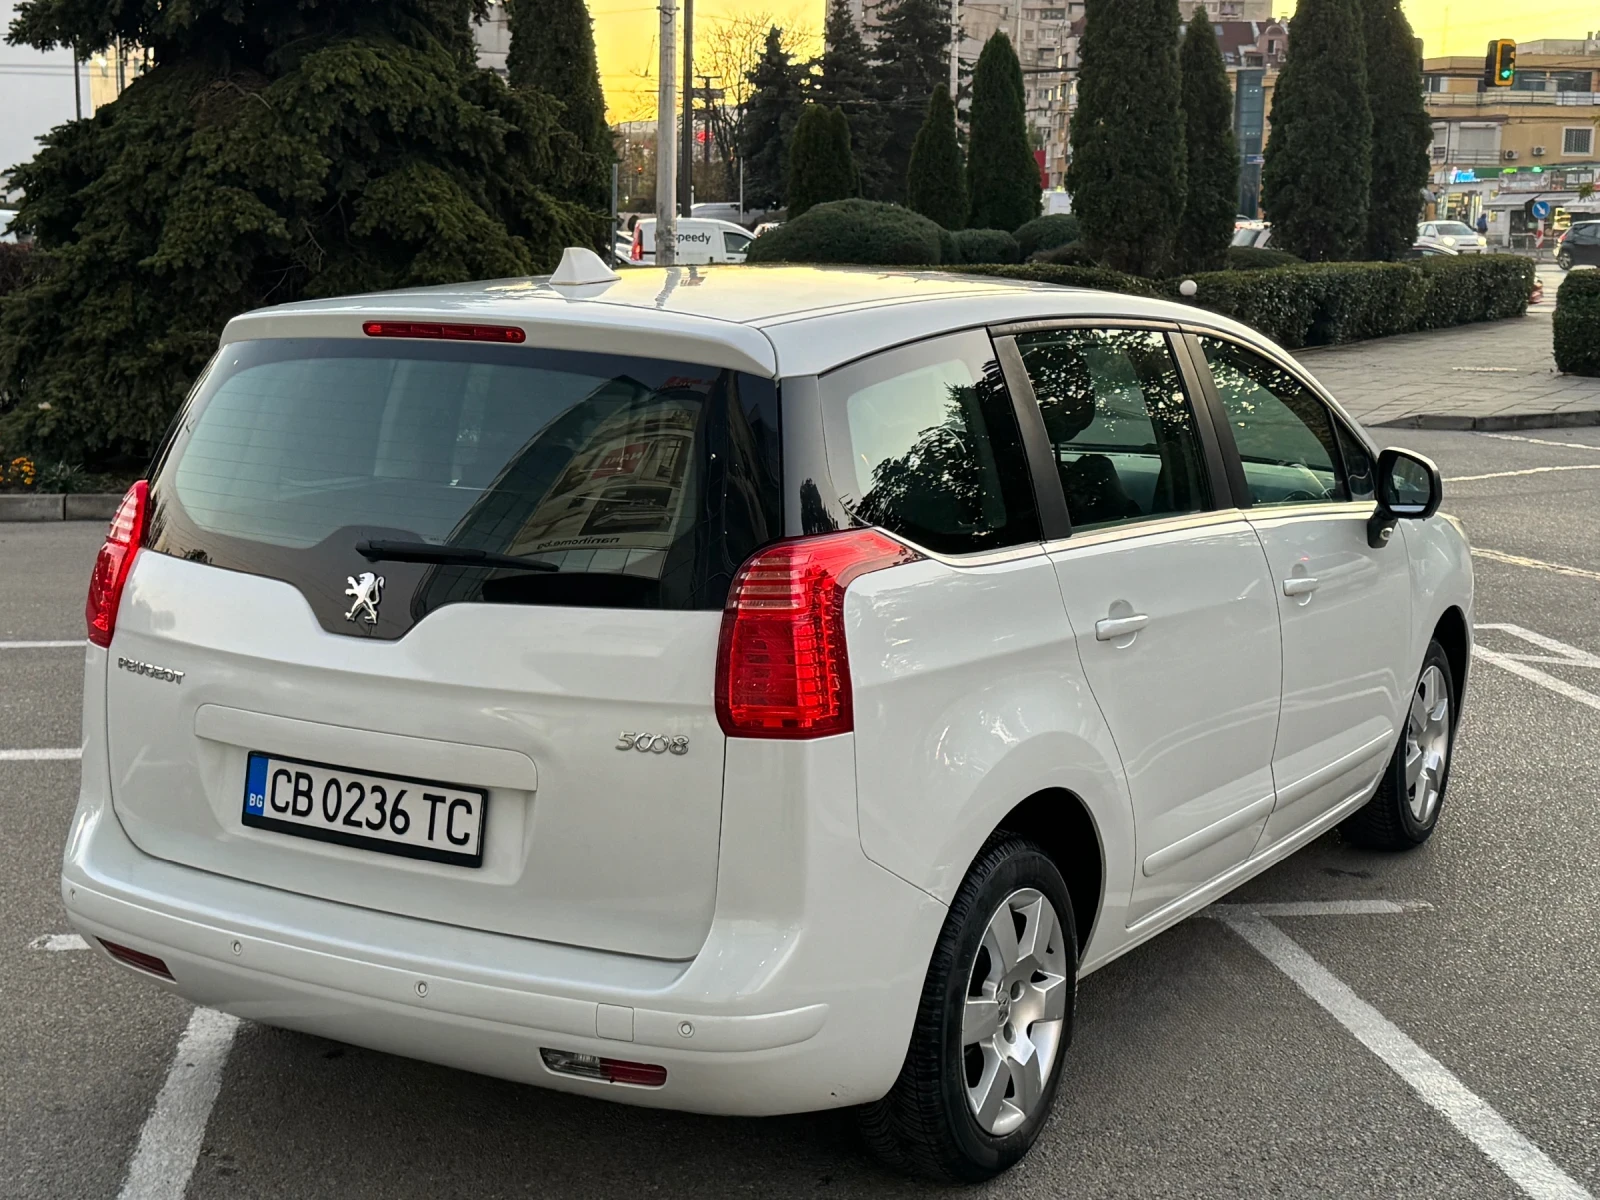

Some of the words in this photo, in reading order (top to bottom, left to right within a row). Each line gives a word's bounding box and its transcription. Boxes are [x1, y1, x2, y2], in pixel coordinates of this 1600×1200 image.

[675, 232, 711, 245] peedy
[118, 657, 185, 684] PEUGEOT
[615, 731, 689, 756] 5008
[249, 793, 263, 808] BG
[270, 768, 314, 818] CB
[322, 777, 411, 835] 0236
[422, 793, 473, 846] TC
